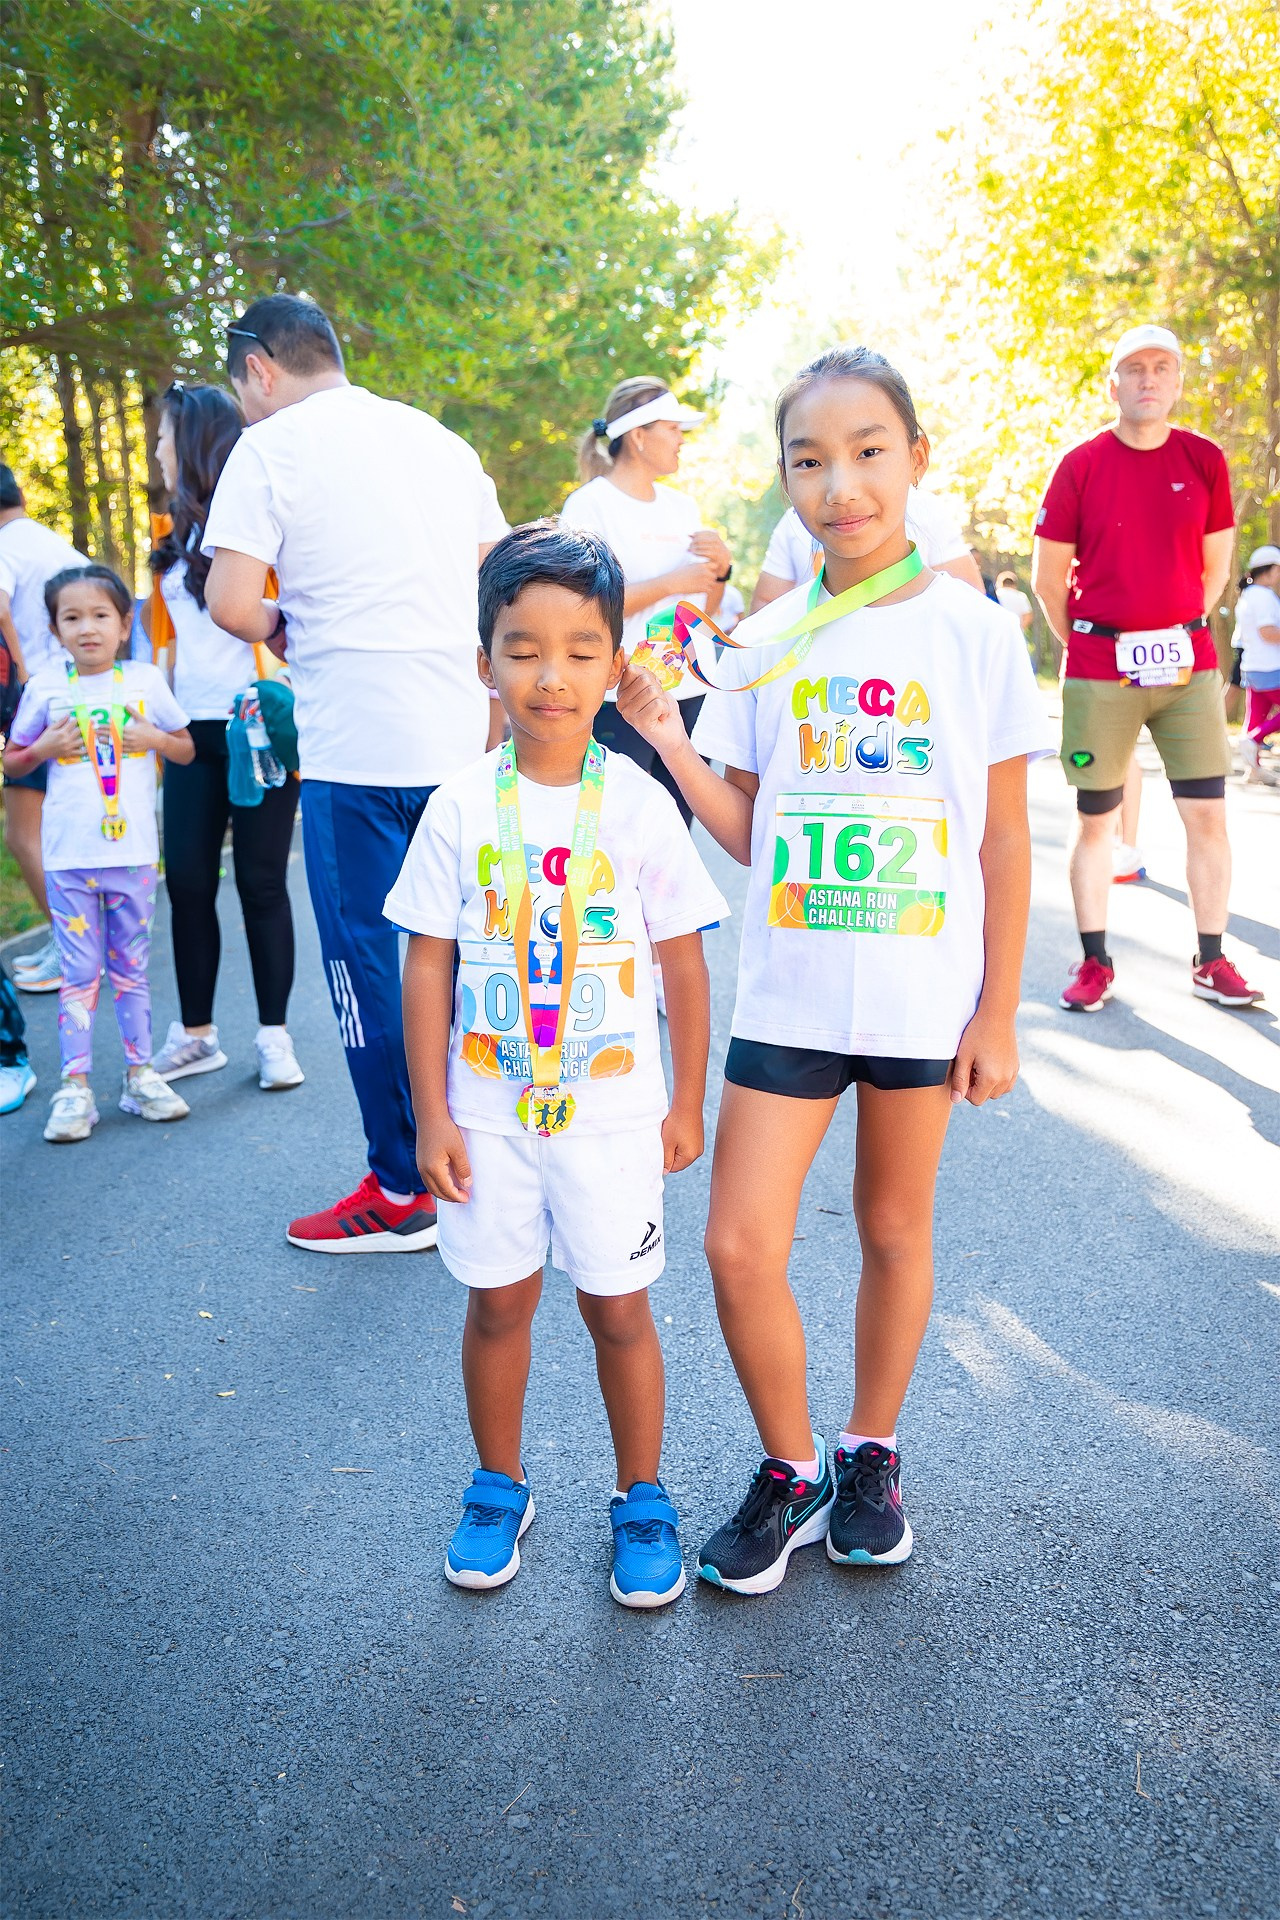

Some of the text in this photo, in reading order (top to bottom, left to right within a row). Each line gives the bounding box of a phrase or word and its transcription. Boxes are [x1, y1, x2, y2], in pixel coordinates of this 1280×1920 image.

[1133, 642, 1181, 666] 005
[791, 675, 931, 727] MEGA
[802, 822, 918, 885] 162
[808, 888, 898, 910] ASTANA RUN
[808, 907, 898, 930] CHALLENGE
[484, 972, 606, 1032] 09
[501, 1040, 532, 1059] ASTA
[503, 1059, 588, 1079] CHANGE
